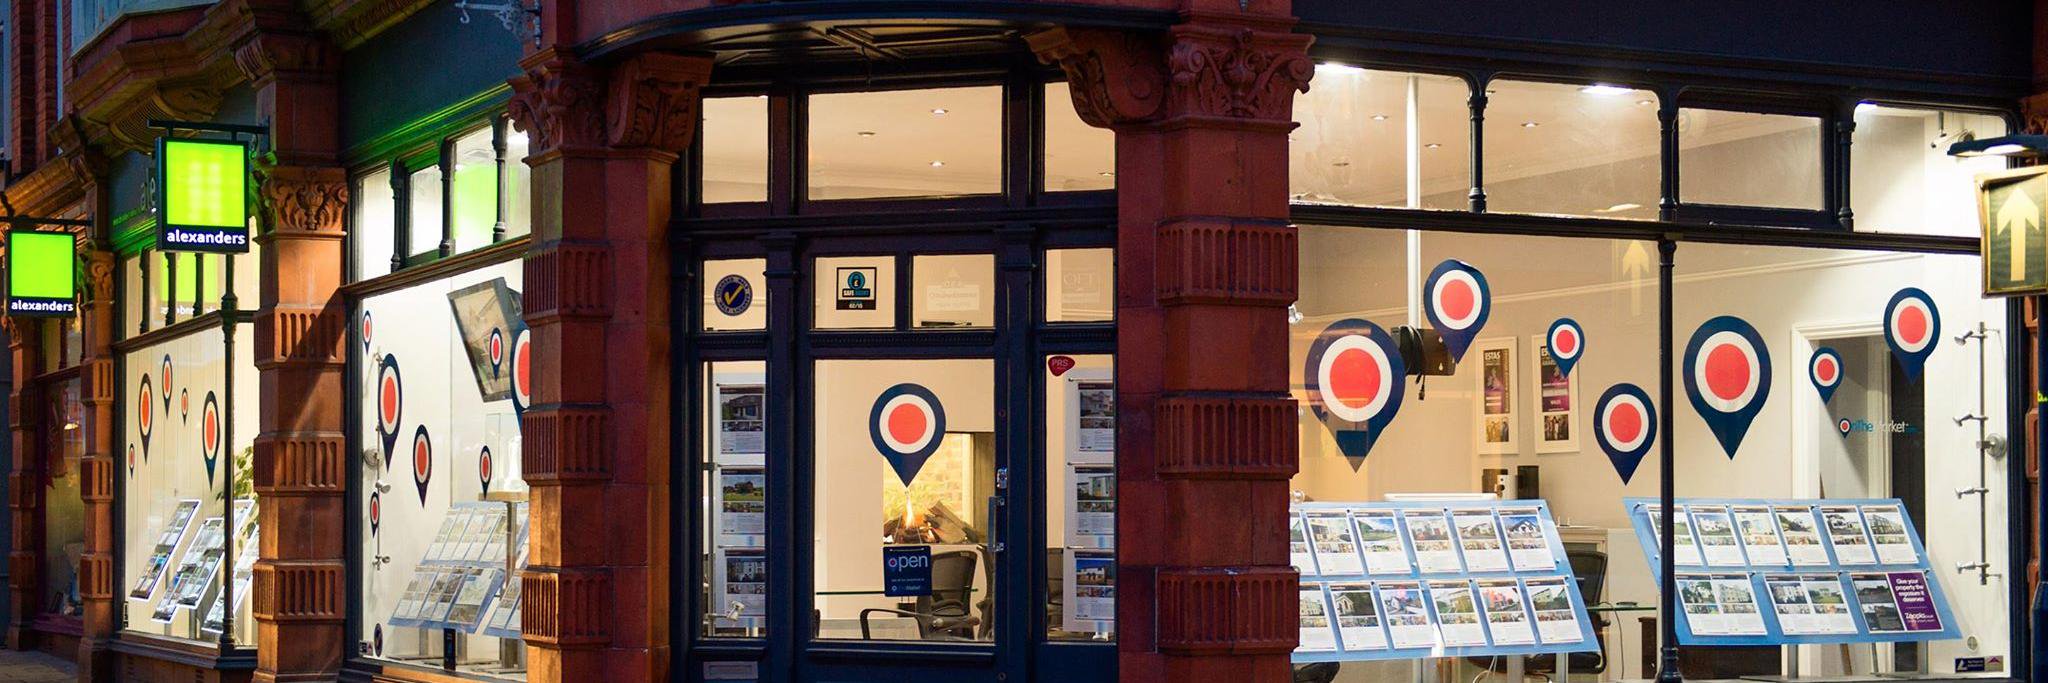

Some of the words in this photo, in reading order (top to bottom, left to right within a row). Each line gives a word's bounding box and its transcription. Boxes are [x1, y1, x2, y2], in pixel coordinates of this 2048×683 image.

[166, 228, 246, 245] alexanders
[11, 299, 74, 312] alexanders
[1051, 359, 1069, 367] PRS
[888, 555, 929, 572] open
